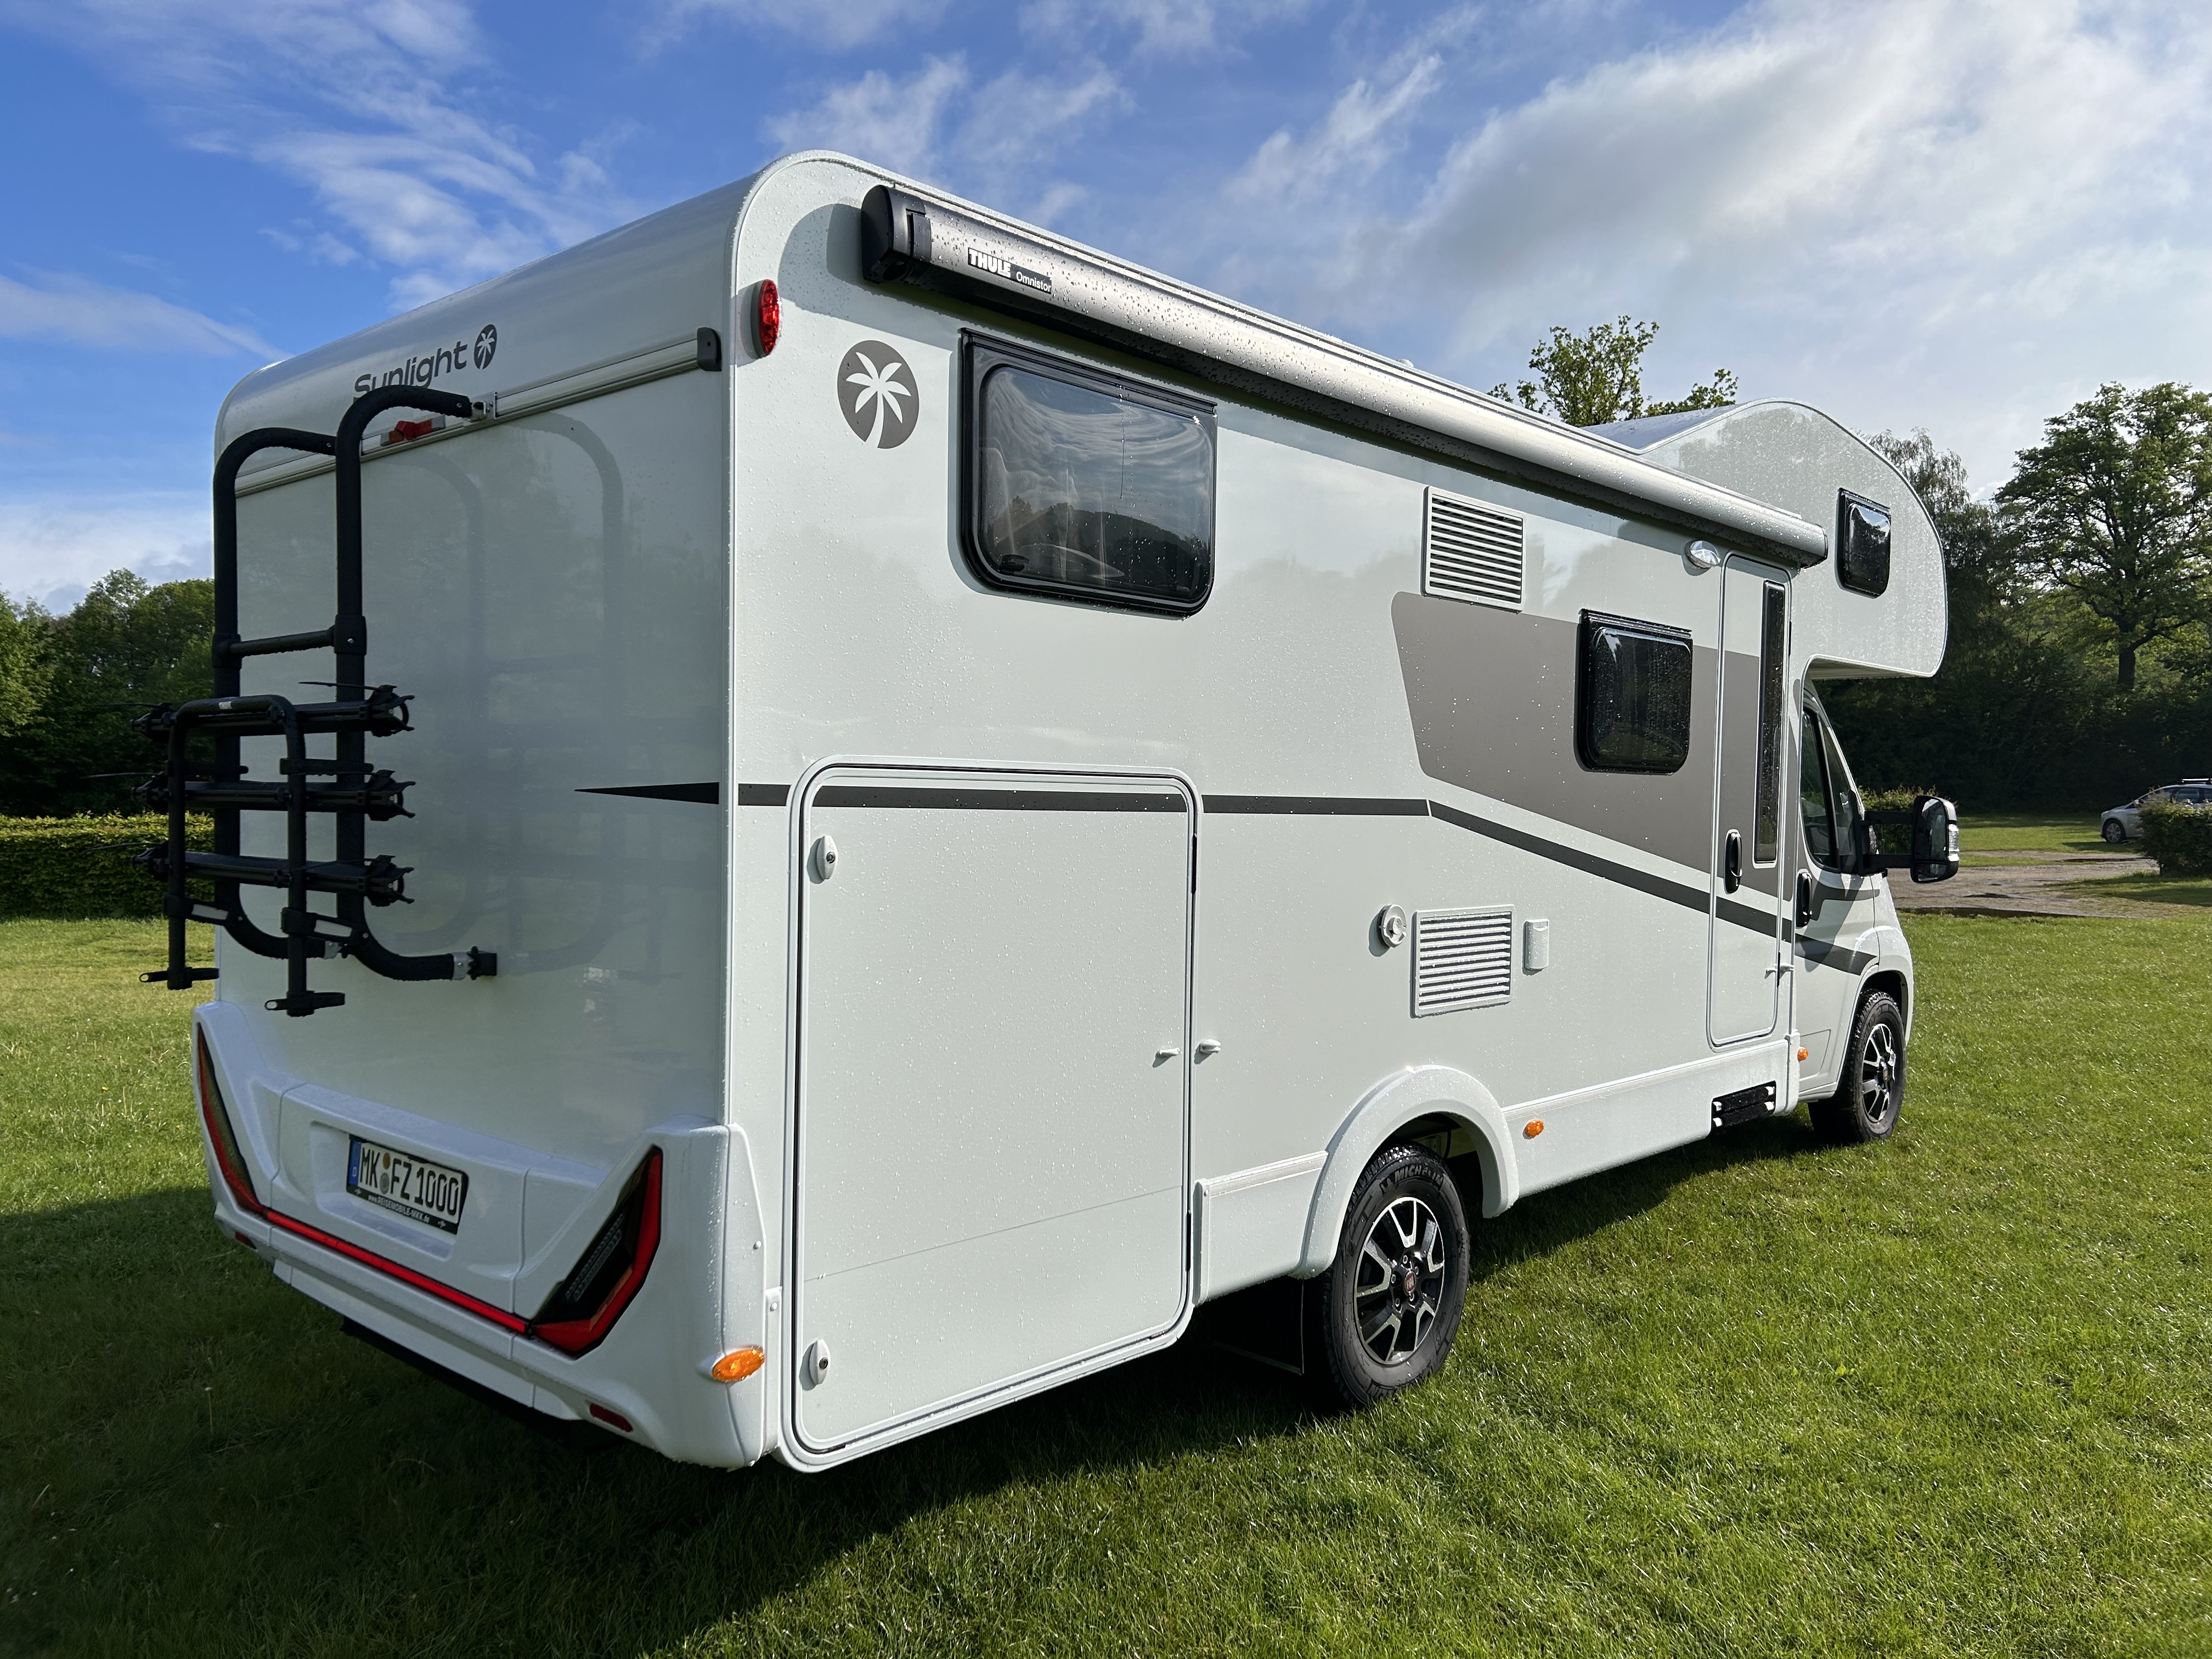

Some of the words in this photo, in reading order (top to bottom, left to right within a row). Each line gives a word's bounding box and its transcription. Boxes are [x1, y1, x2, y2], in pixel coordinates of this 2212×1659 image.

[969, 247, 1011, 278] THULE
[1016, 271, 1052, 292] Omnistor
[354, 341, 467, 403] Sunlight
[359, 1147, 380, 1188] MK
[390, 1158, 412, 1200] FZ
[414, 1167, 459, 1216] 1000
